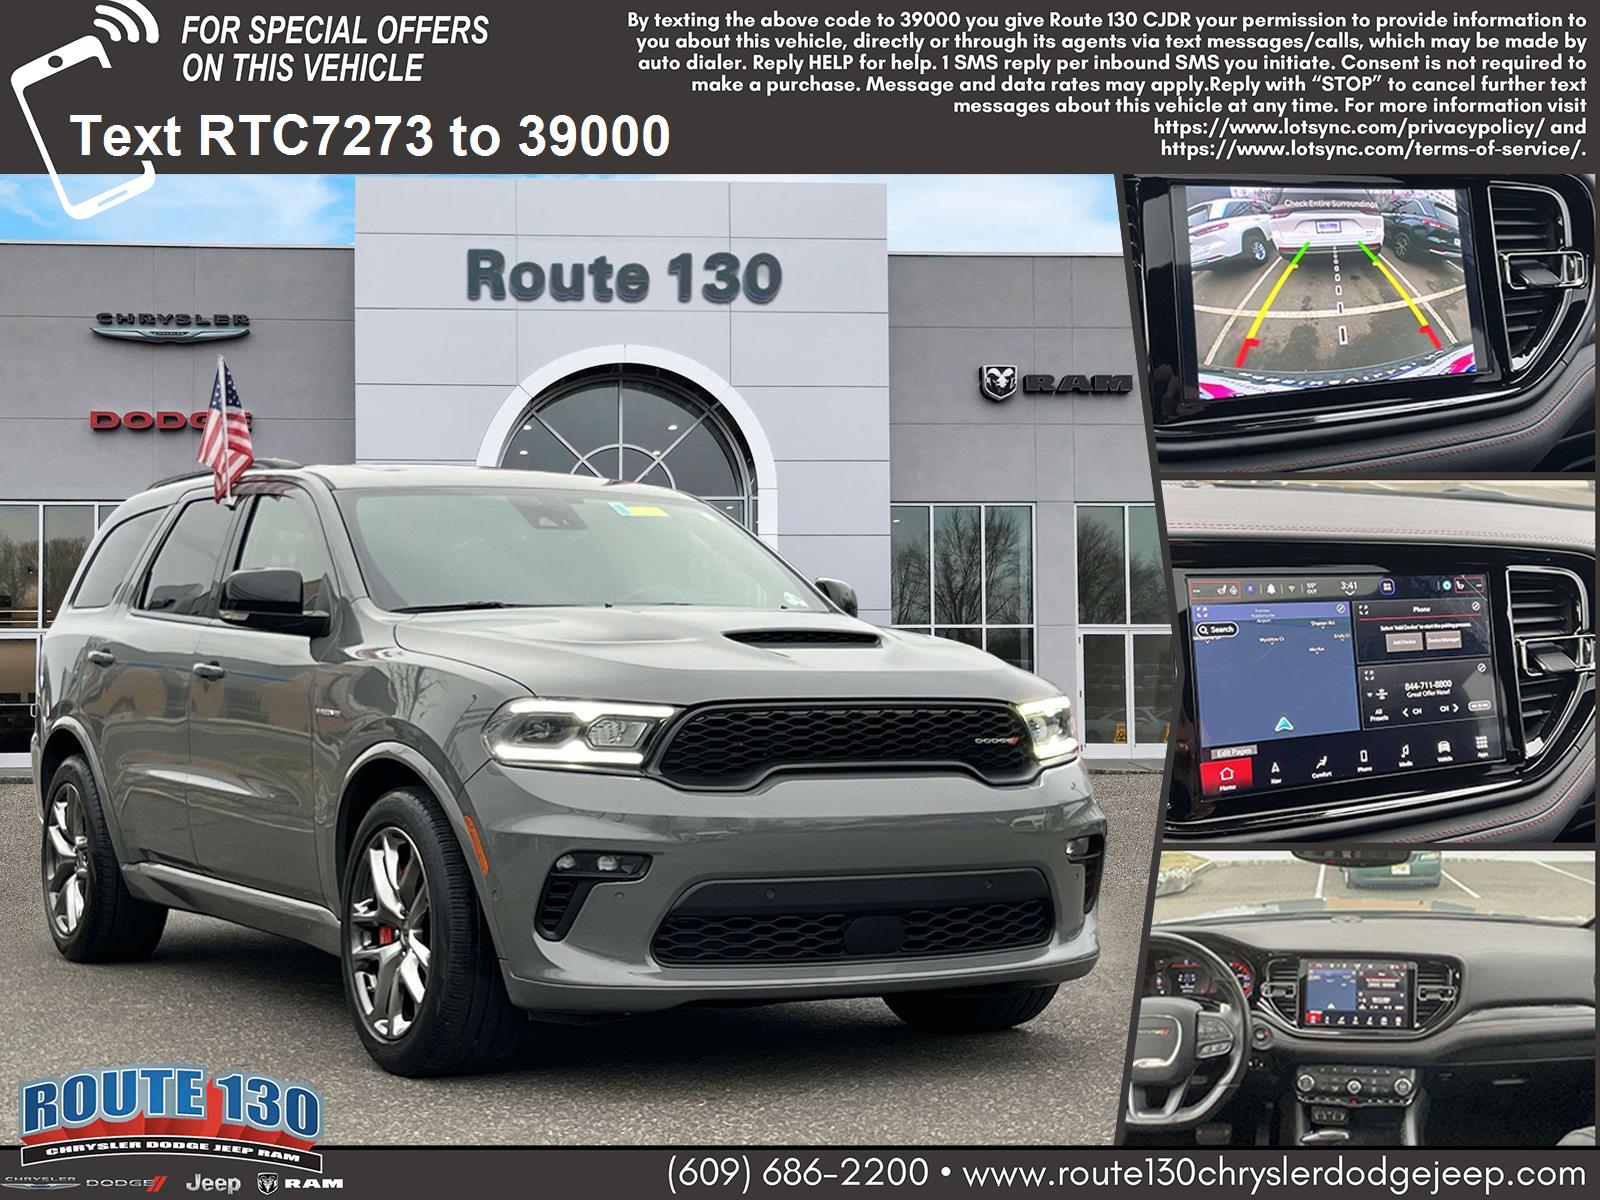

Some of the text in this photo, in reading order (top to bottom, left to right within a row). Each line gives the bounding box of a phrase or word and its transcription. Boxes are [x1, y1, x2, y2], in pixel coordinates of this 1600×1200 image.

[1331, 200, 1378, 209] Surroundings
[467, 249, 783, 304] Route 130
[96, 312, 250, 326] CHRYSLER
[1023, 375, 1133, 393] RAM
[1341, 581, 1358, 590] 3:41
[1217, 748, 1252, 757] Edit Pages
[1311, 771, 1333, 779] Comfort
